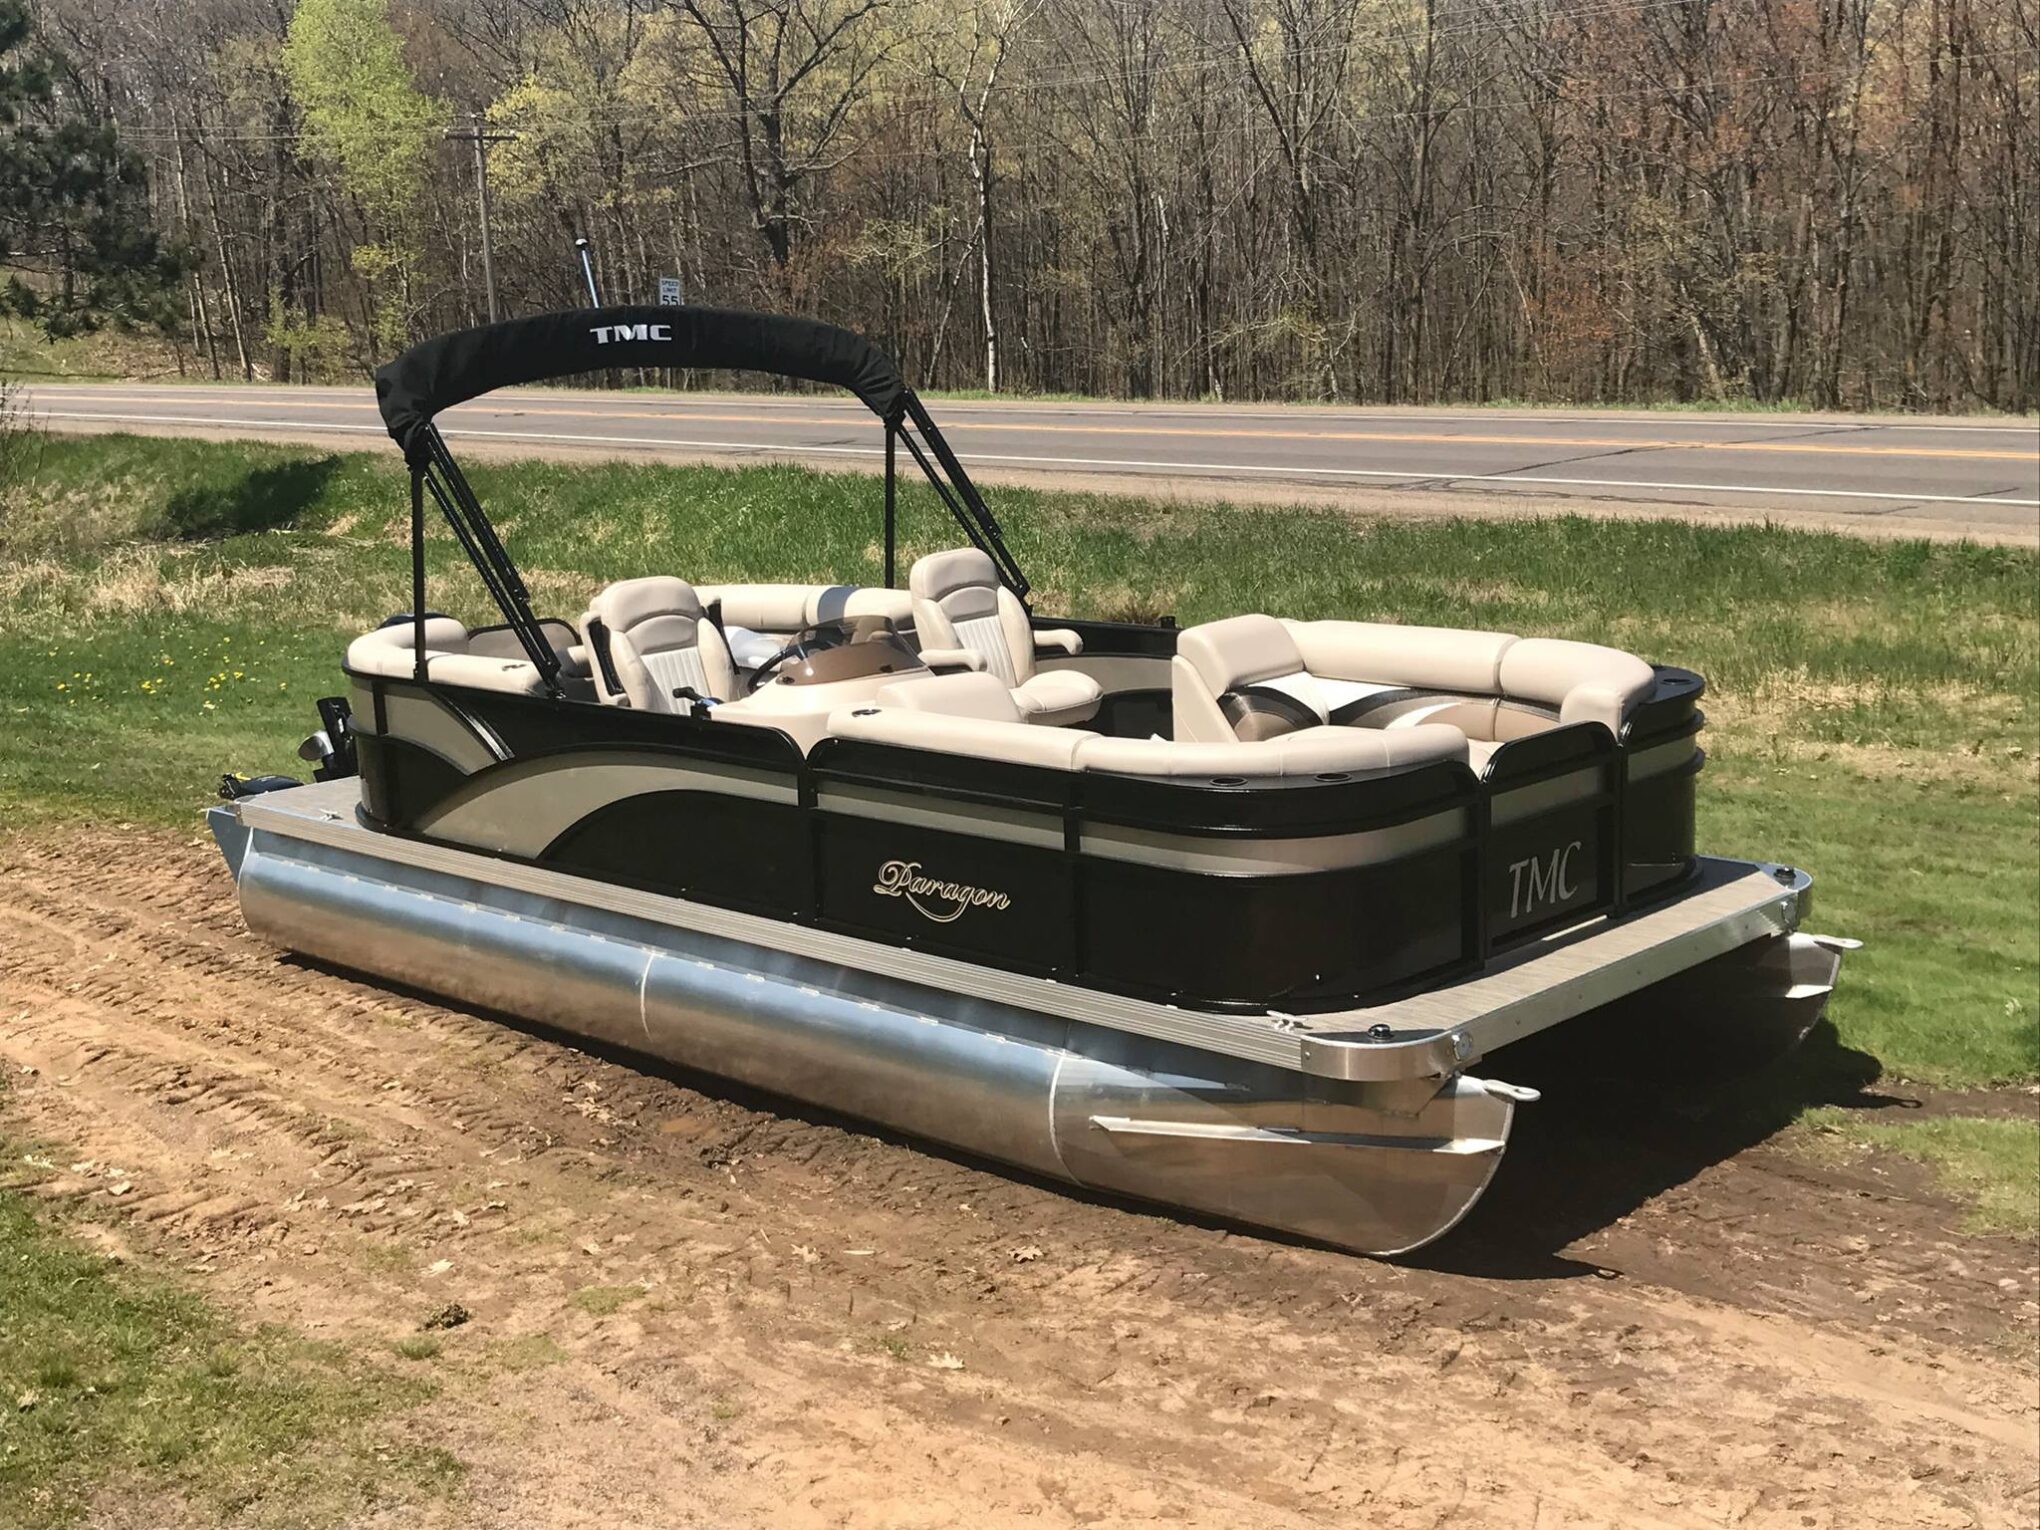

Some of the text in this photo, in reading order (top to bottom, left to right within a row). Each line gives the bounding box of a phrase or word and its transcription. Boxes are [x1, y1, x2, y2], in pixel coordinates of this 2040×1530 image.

[662, 295, 679, 306] 55
[589, 324, 672, 344] TMC
[873, 860, 1011, 923] Paragon
[1509, 841, 1582, 919] TMC
